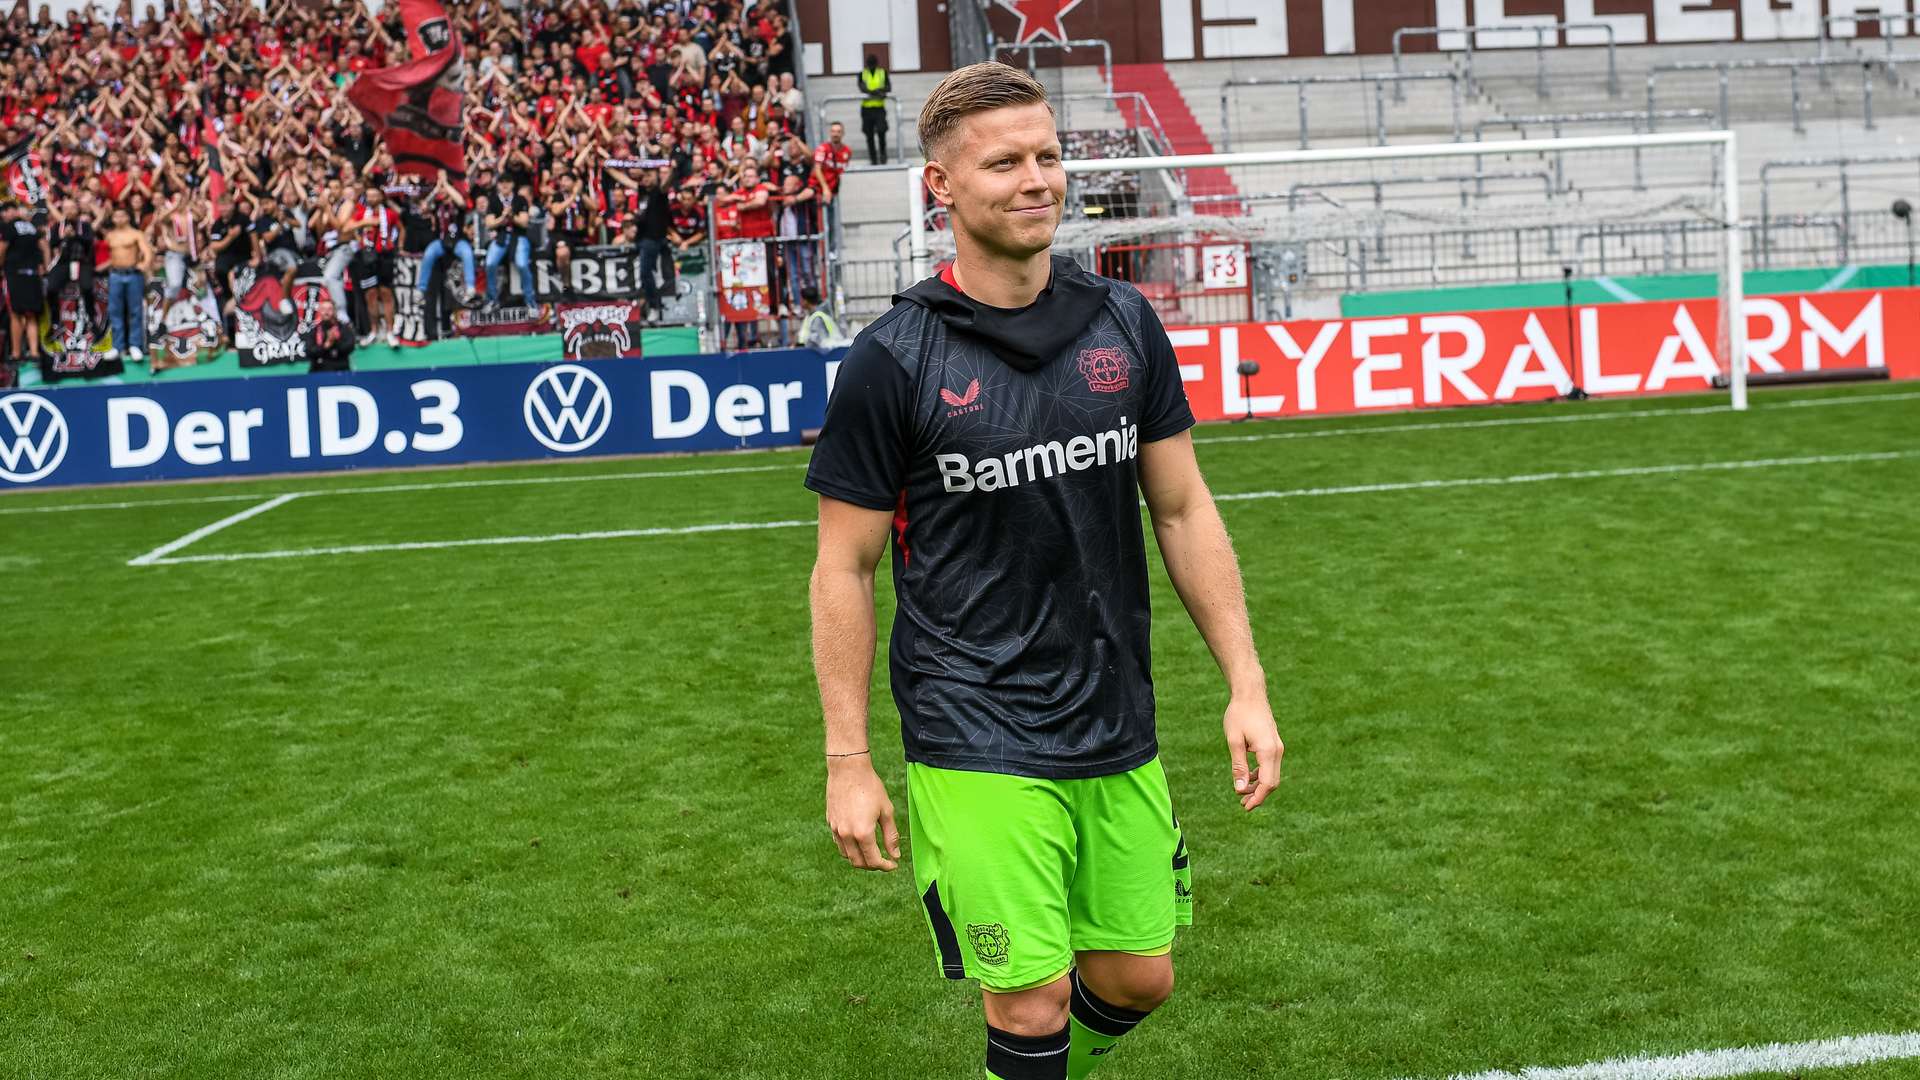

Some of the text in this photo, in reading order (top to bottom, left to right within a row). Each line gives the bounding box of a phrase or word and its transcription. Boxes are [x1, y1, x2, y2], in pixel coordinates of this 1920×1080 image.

[1212, 254, 1236, 277] F3
[107, 378, 464, 469] Der ID.3
[650, 368, 803, 440] Der
[935, 416, 1138, 493] Barmenia
